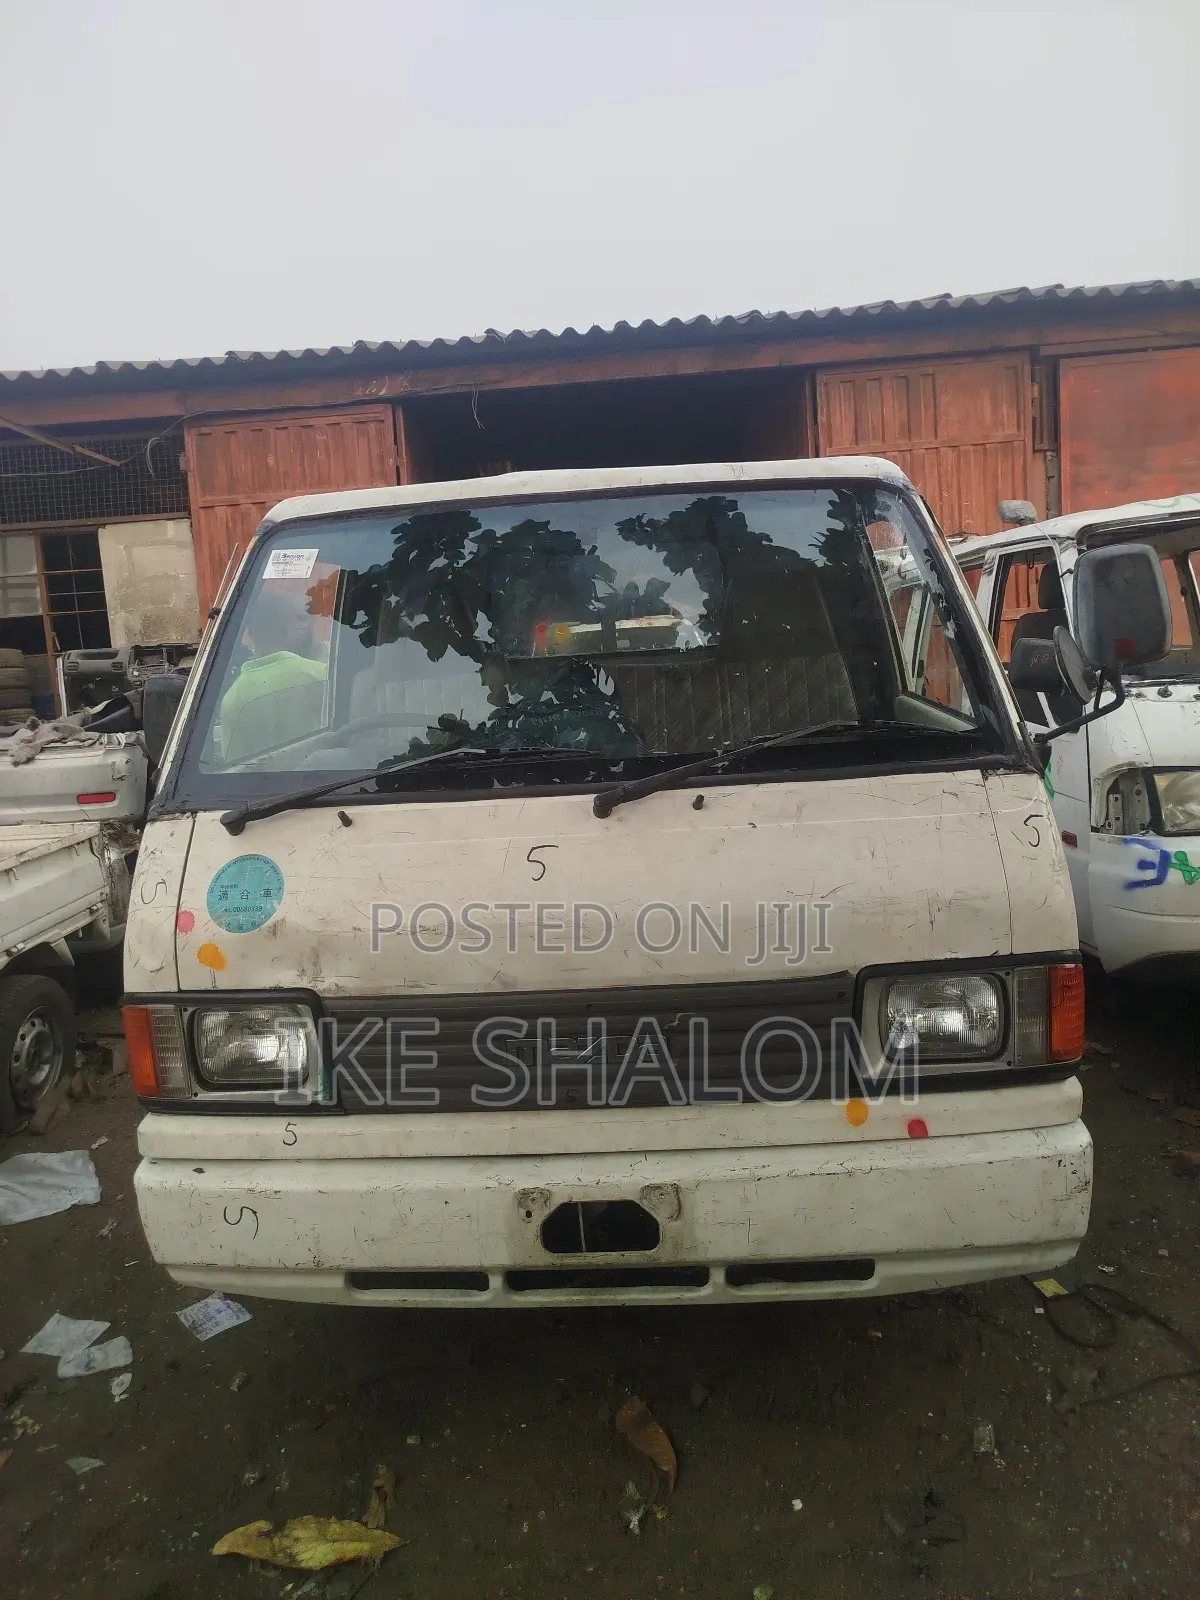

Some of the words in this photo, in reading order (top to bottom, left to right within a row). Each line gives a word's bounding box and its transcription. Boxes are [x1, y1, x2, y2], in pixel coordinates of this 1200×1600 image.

[1023, 814, 1044, 847] 5
[526, 845, 559, 881] 5
[283, 1122, 297, 1146] 5
